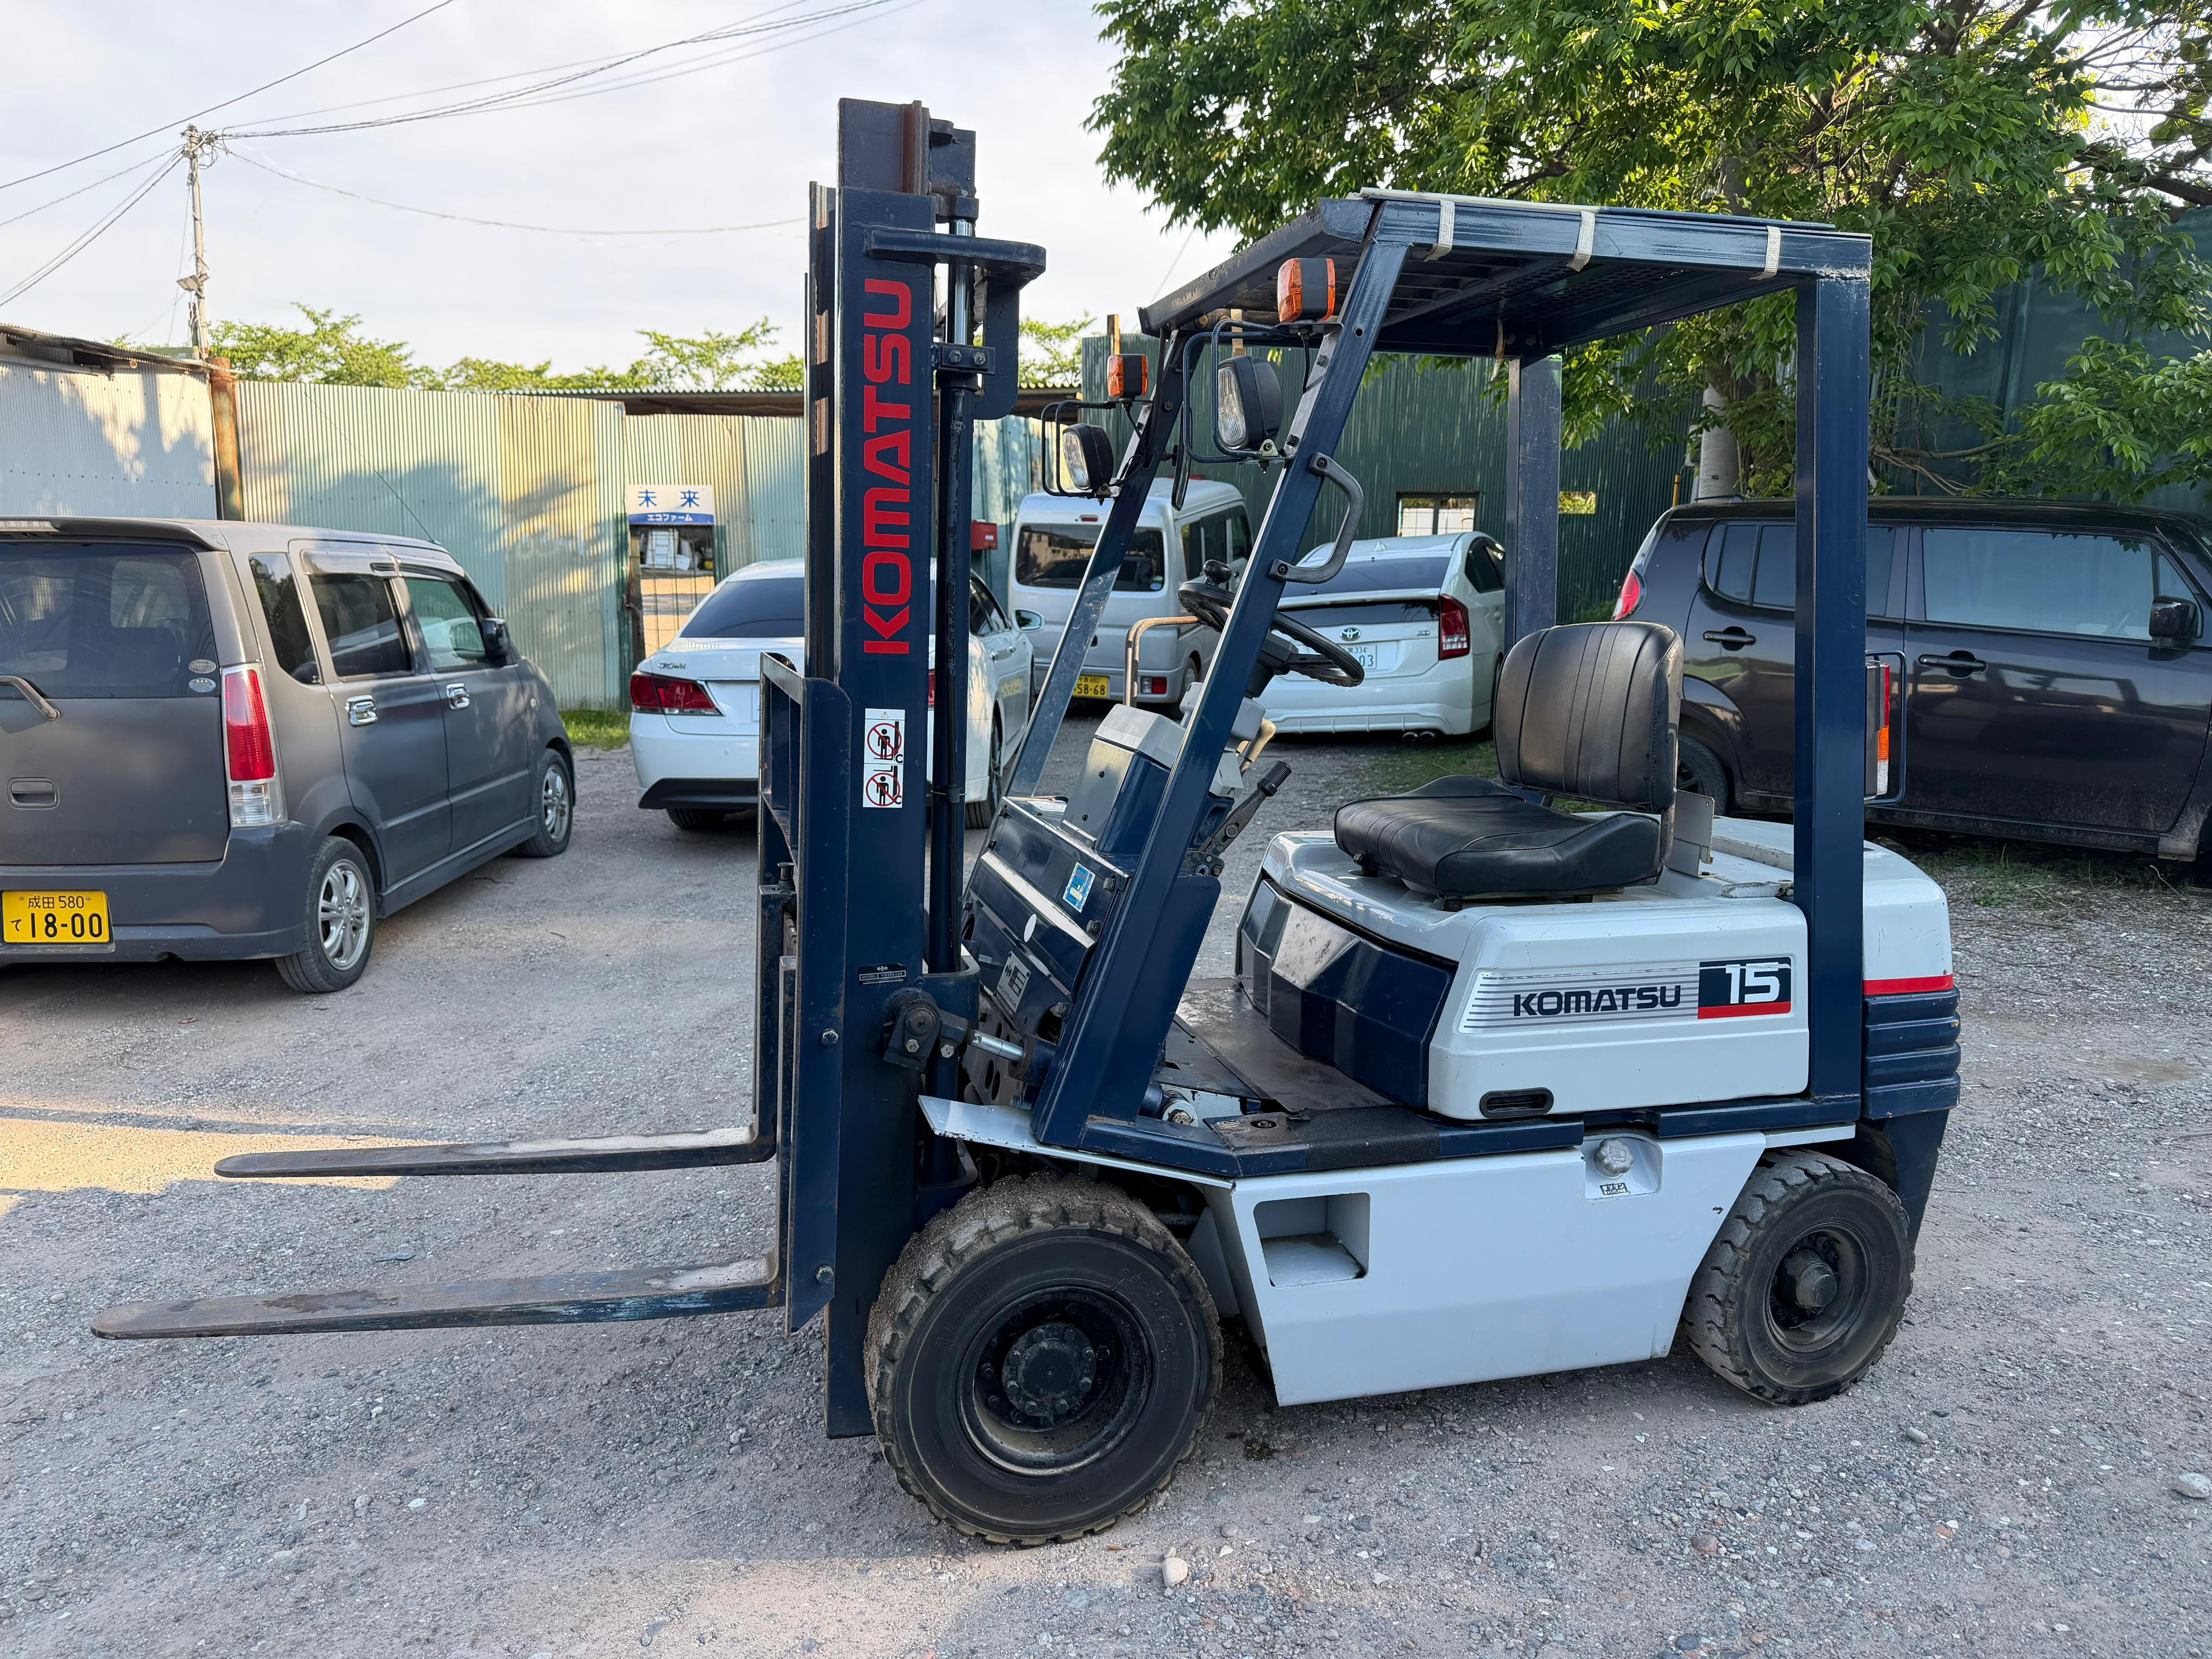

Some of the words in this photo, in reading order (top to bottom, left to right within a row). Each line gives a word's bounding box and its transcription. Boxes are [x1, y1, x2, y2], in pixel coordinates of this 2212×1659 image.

[862, 278, 911, 654] KOMATSU
[638, 489, 700, 507] 未来
[1077, 683, 1105, 696] 58-68
[28, 895, 55, 909] 成田
[58, 895, 84, 909] 580
[10, 919, 22, 932] て
[31, 912, 103, 938] 18-00
[1513, 985, 1681, 1017] KOMATSU
[1725, 961, 1780, 1005] 15
